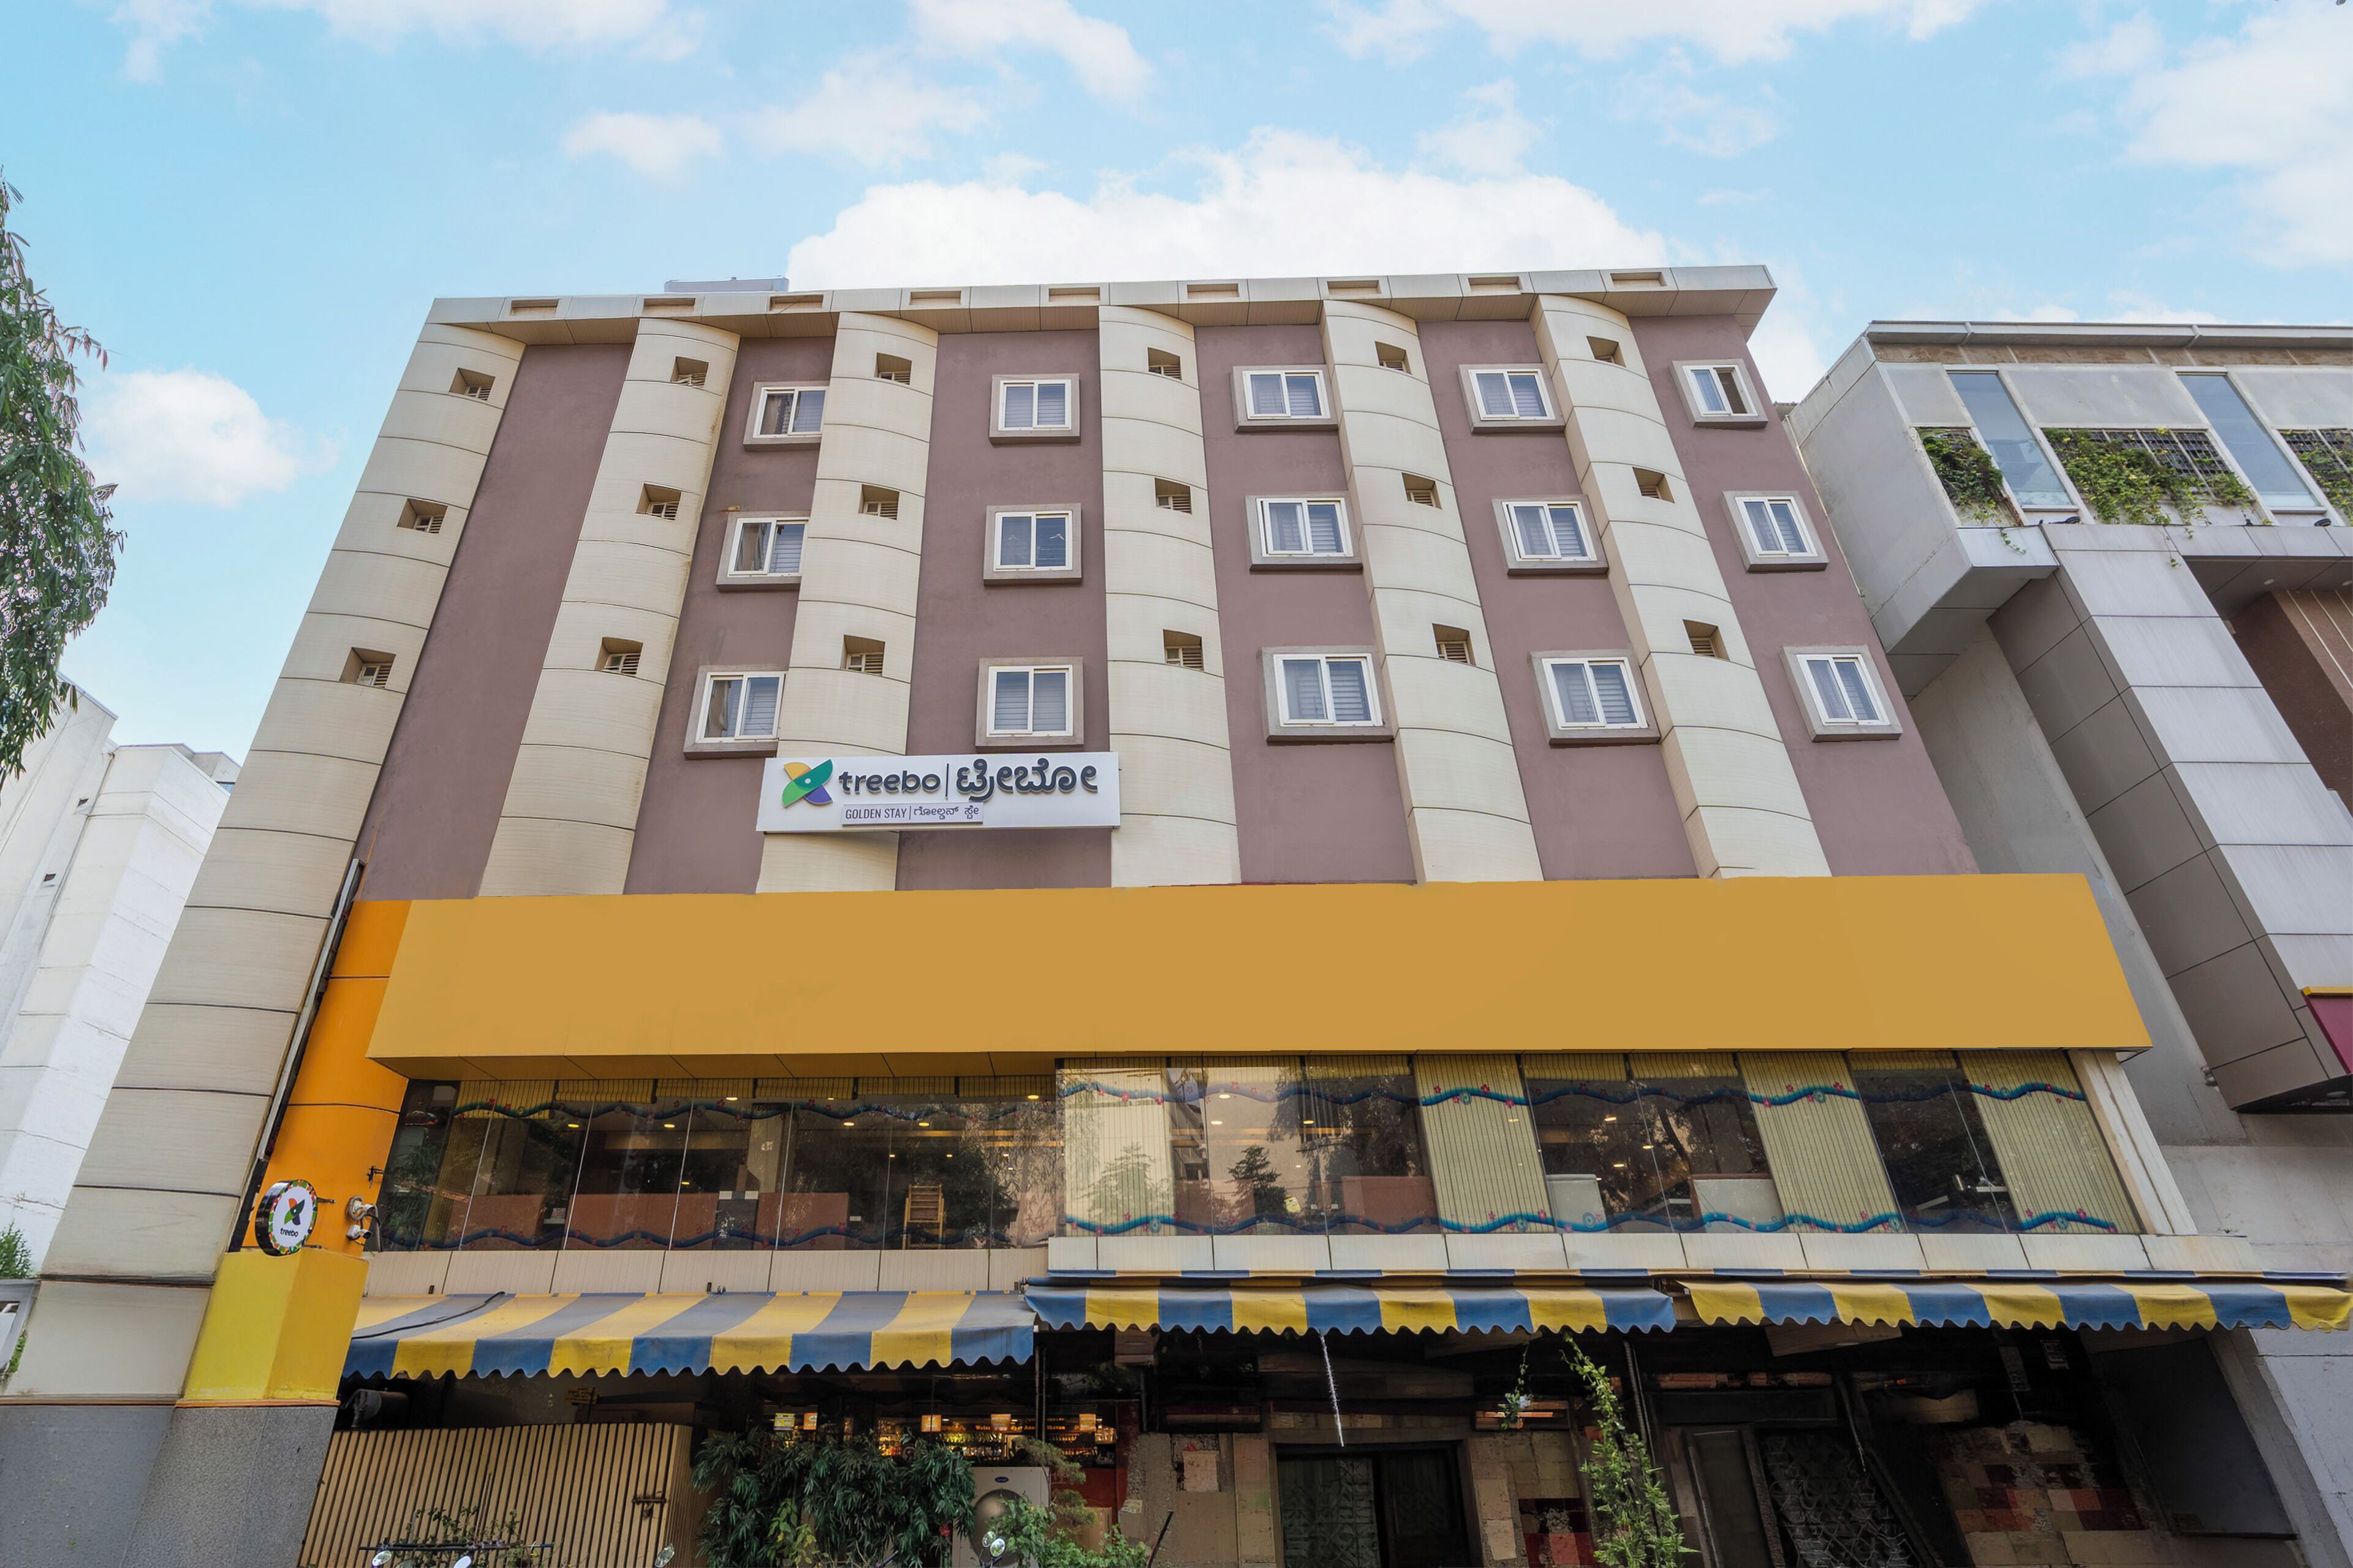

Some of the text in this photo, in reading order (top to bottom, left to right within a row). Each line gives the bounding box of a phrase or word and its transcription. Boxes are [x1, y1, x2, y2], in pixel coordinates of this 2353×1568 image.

[839, 770, 941, 794] treebo
[957, 758, 1098, 801] ಟ್ರೀಬೋ
[846, 808, 907, 819] GOLDEN STAY
[964, 805, 980, 820] ಸ್ಟೇ
[280, 1227, 299, 1237] treebo
